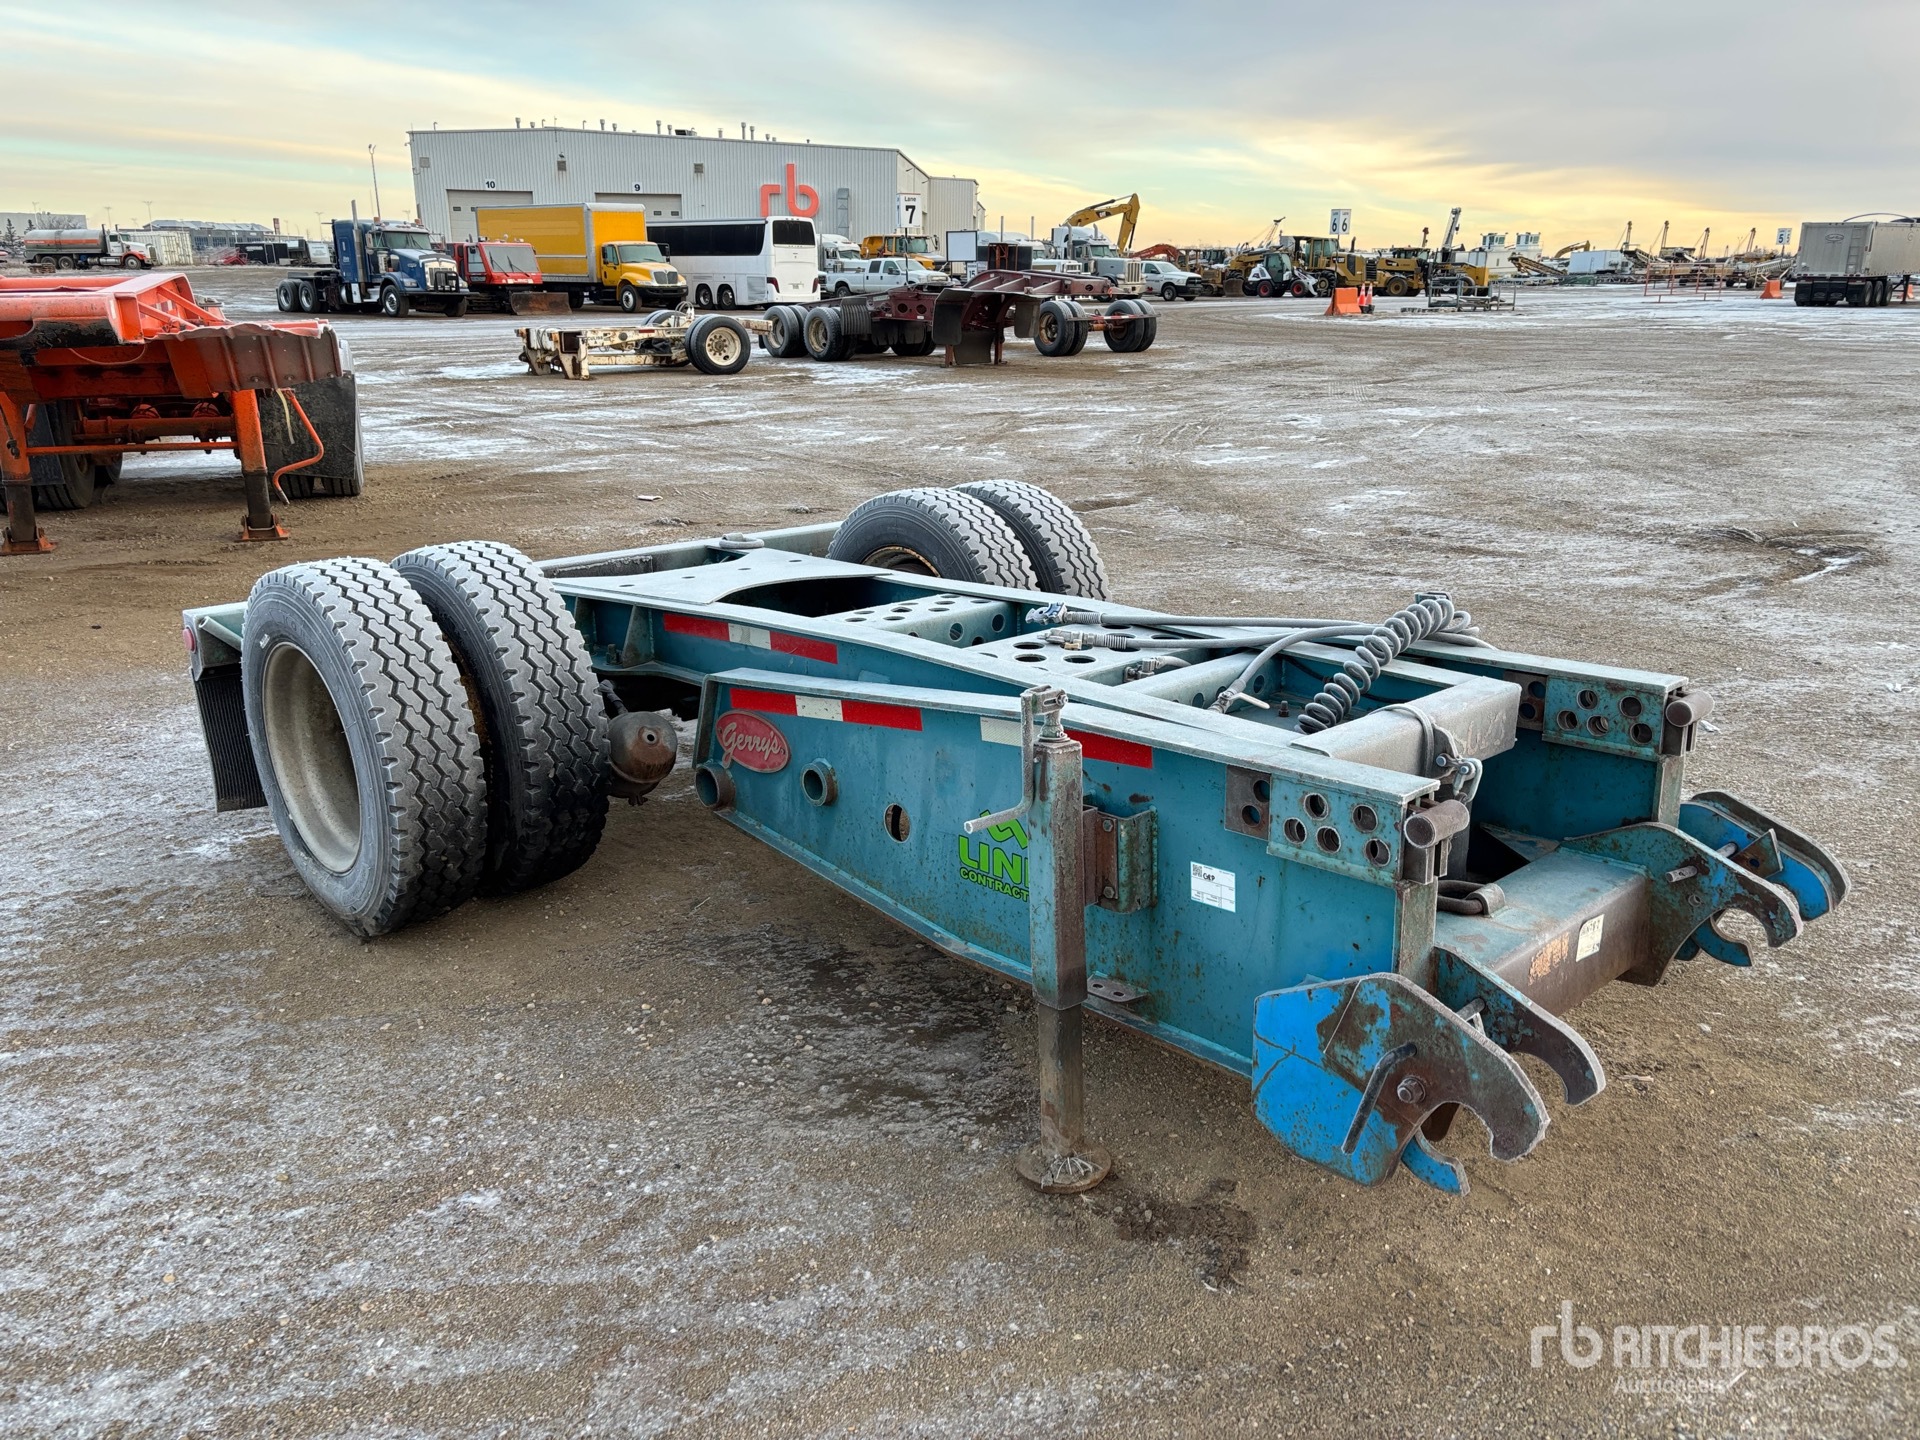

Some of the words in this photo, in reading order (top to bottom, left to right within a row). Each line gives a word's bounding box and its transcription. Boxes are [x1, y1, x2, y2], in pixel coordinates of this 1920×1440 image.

[485, 181, 496, 189] 10
[634, 183, 641, 191] 9
[760, 163, 819, 218] rb
[905, 205, 916, 224] 7
[1332, 218, 1337, 232] 6
[1342, 218, 1348, 232] 6
[1778, 234, 1784, 243] 5
[722, 722, 781, 769] Gerry's
[958, 834, 1030, 889] LIN
